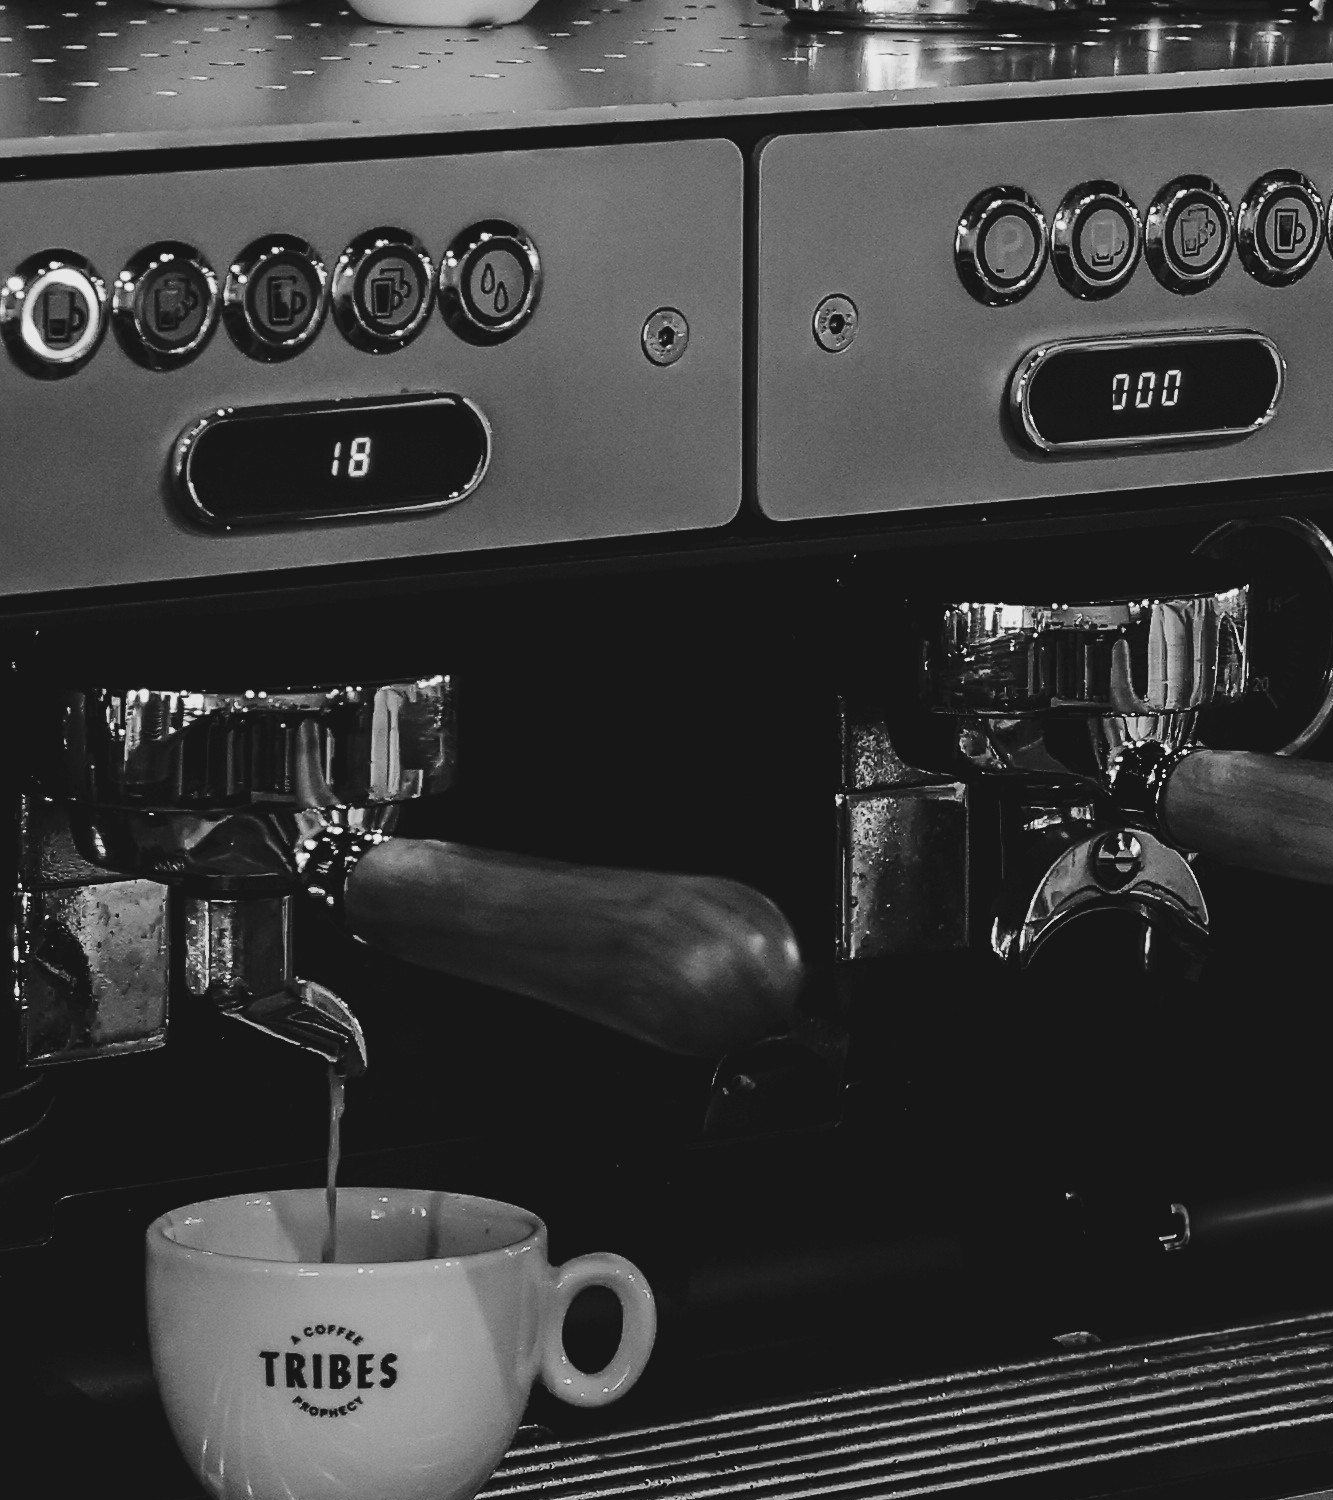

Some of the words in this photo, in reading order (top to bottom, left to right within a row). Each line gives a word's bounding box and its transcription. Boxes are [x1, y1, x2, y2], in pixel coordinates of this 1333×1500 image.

[331, 436, 372, 477] 18
[290, 1334, 301, 1346] A
[303, 1324, 364, 1346] COFFEE
[258, 1351, 398, 1389] TRIBES
[292, 1395, 364, 1418] PROPHECY
